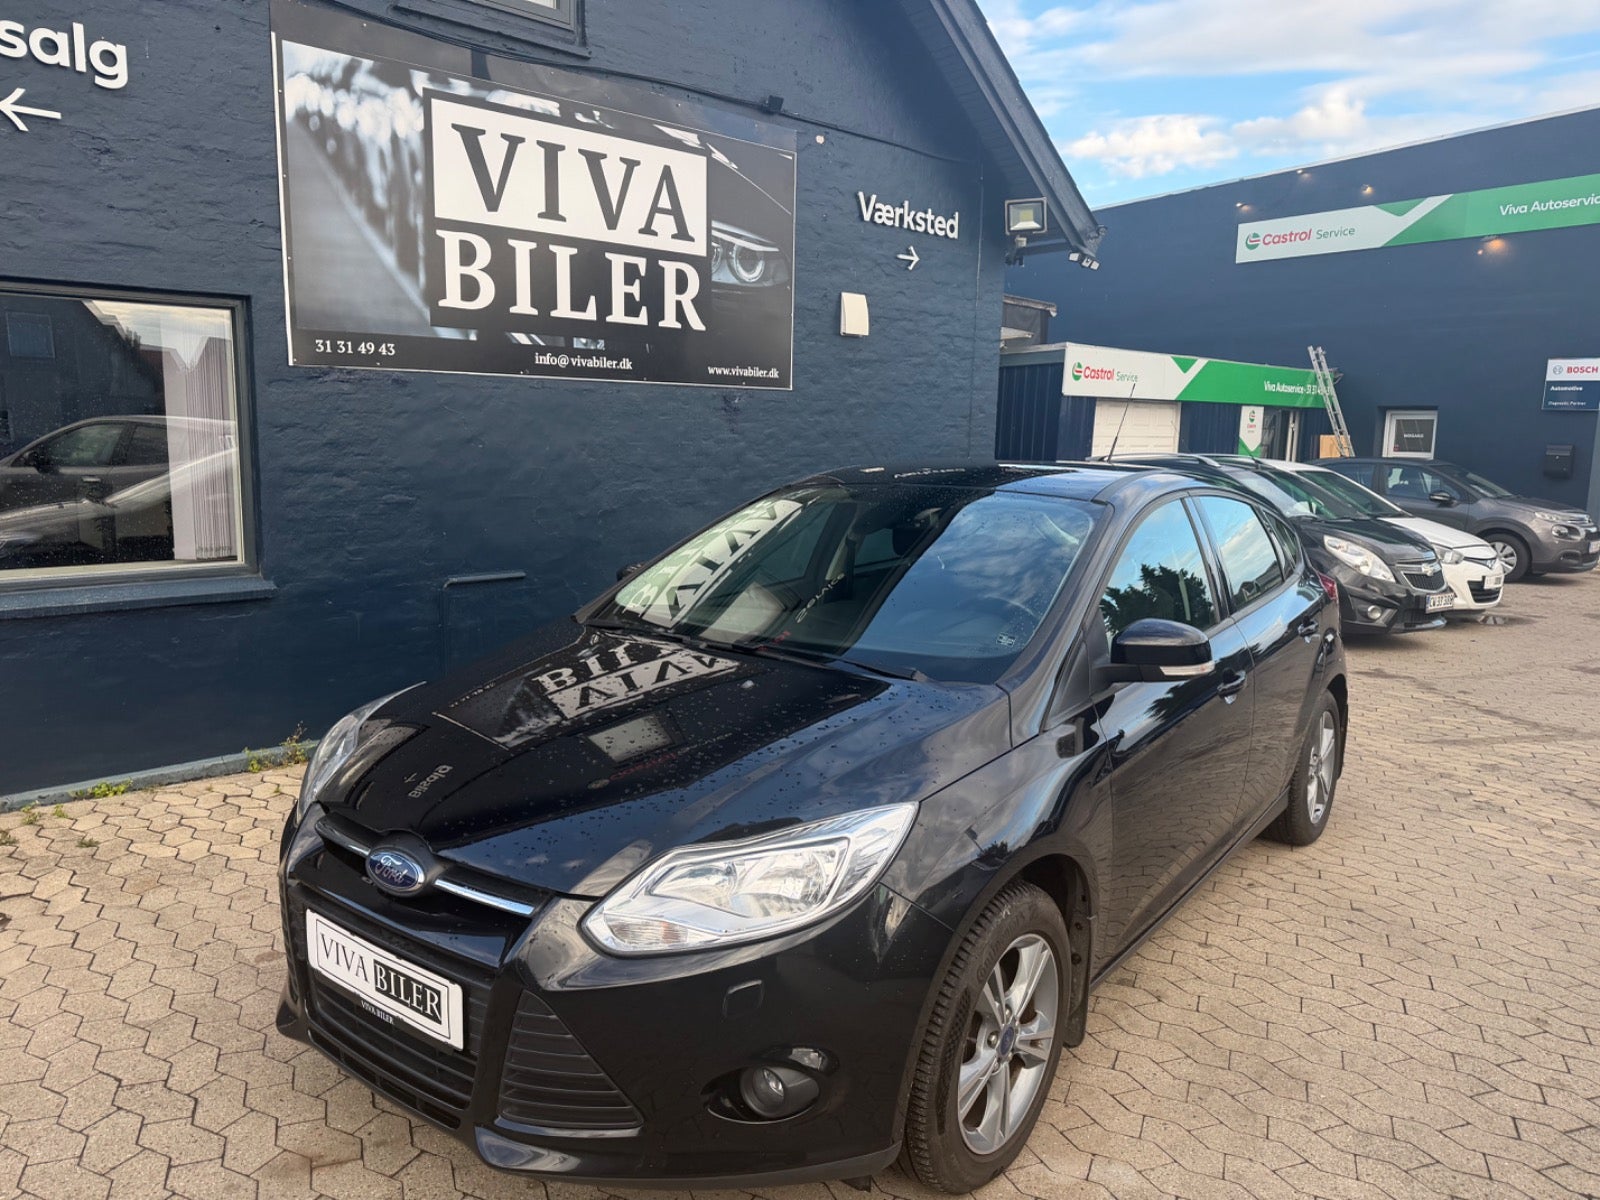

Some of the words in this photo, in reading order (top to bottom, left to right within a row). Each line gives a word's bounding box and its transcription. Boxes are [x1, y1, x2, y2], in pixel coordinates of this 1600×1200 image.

[0, 20, 128, 90] salg
[451, 123, 695, 243] VIVA
[858, 191, 959, 239] Værksted
[1499, 204, 1527, 216] Viva
[1262, 228, 1312, 247] Castrol
[1316, 226, 1356, 240] Service
[436, 229, 706, 332] BILER
[315, 339, 332, 353] 31
[336, 340, 354, 354] 31
[357, 341, 375, 355] 49
[378, 343, 396, 356] 43
[708, 365, 780, 379] www.vivabiler.dk
[1083, 366, 1115, 381] Castrol
[1116, 370, 1138, 383] Service
[1566, 366, 1599, 374] BOSCH
[1264, 380, 1276, 392] Viva
[1276, 381, 1304, 394] Autoservice
[375, 855, 409, 884] Ford
[321, 933, 370, 983] VIVA
[375, 963, 441, 1019] BILER
[361, 1000, 377, 1016] VIVA
[376, 1004, 394, 1024] BILER
